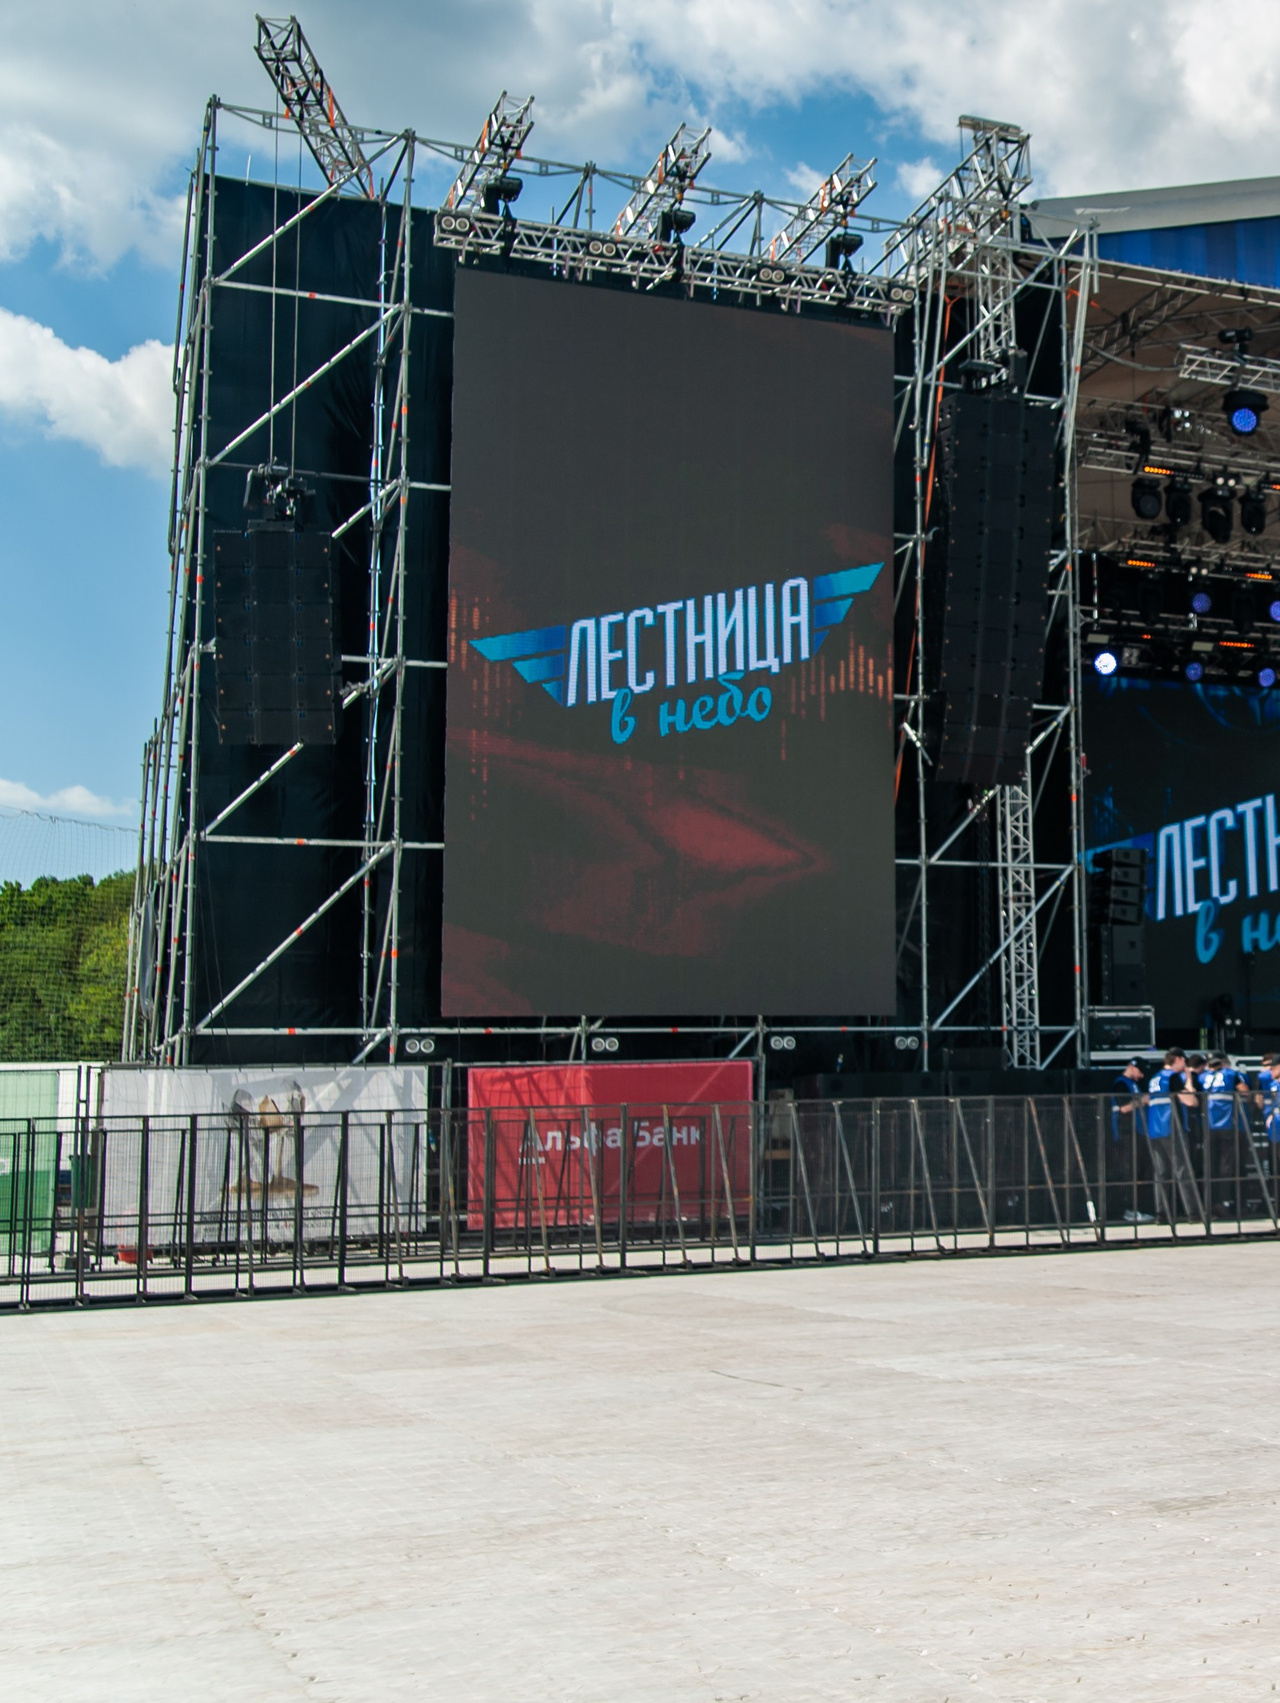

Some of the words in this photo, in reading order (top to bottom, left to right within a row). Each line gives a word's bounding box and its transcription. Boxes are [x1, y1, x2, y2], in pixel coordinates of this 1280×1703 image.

[567, 576, 810, 707] ЛЕСТНИЦА
[611, 687, 636, 744] в
[659, 672, 772, 736] небо
[1195, 900, 1224, 963] в
